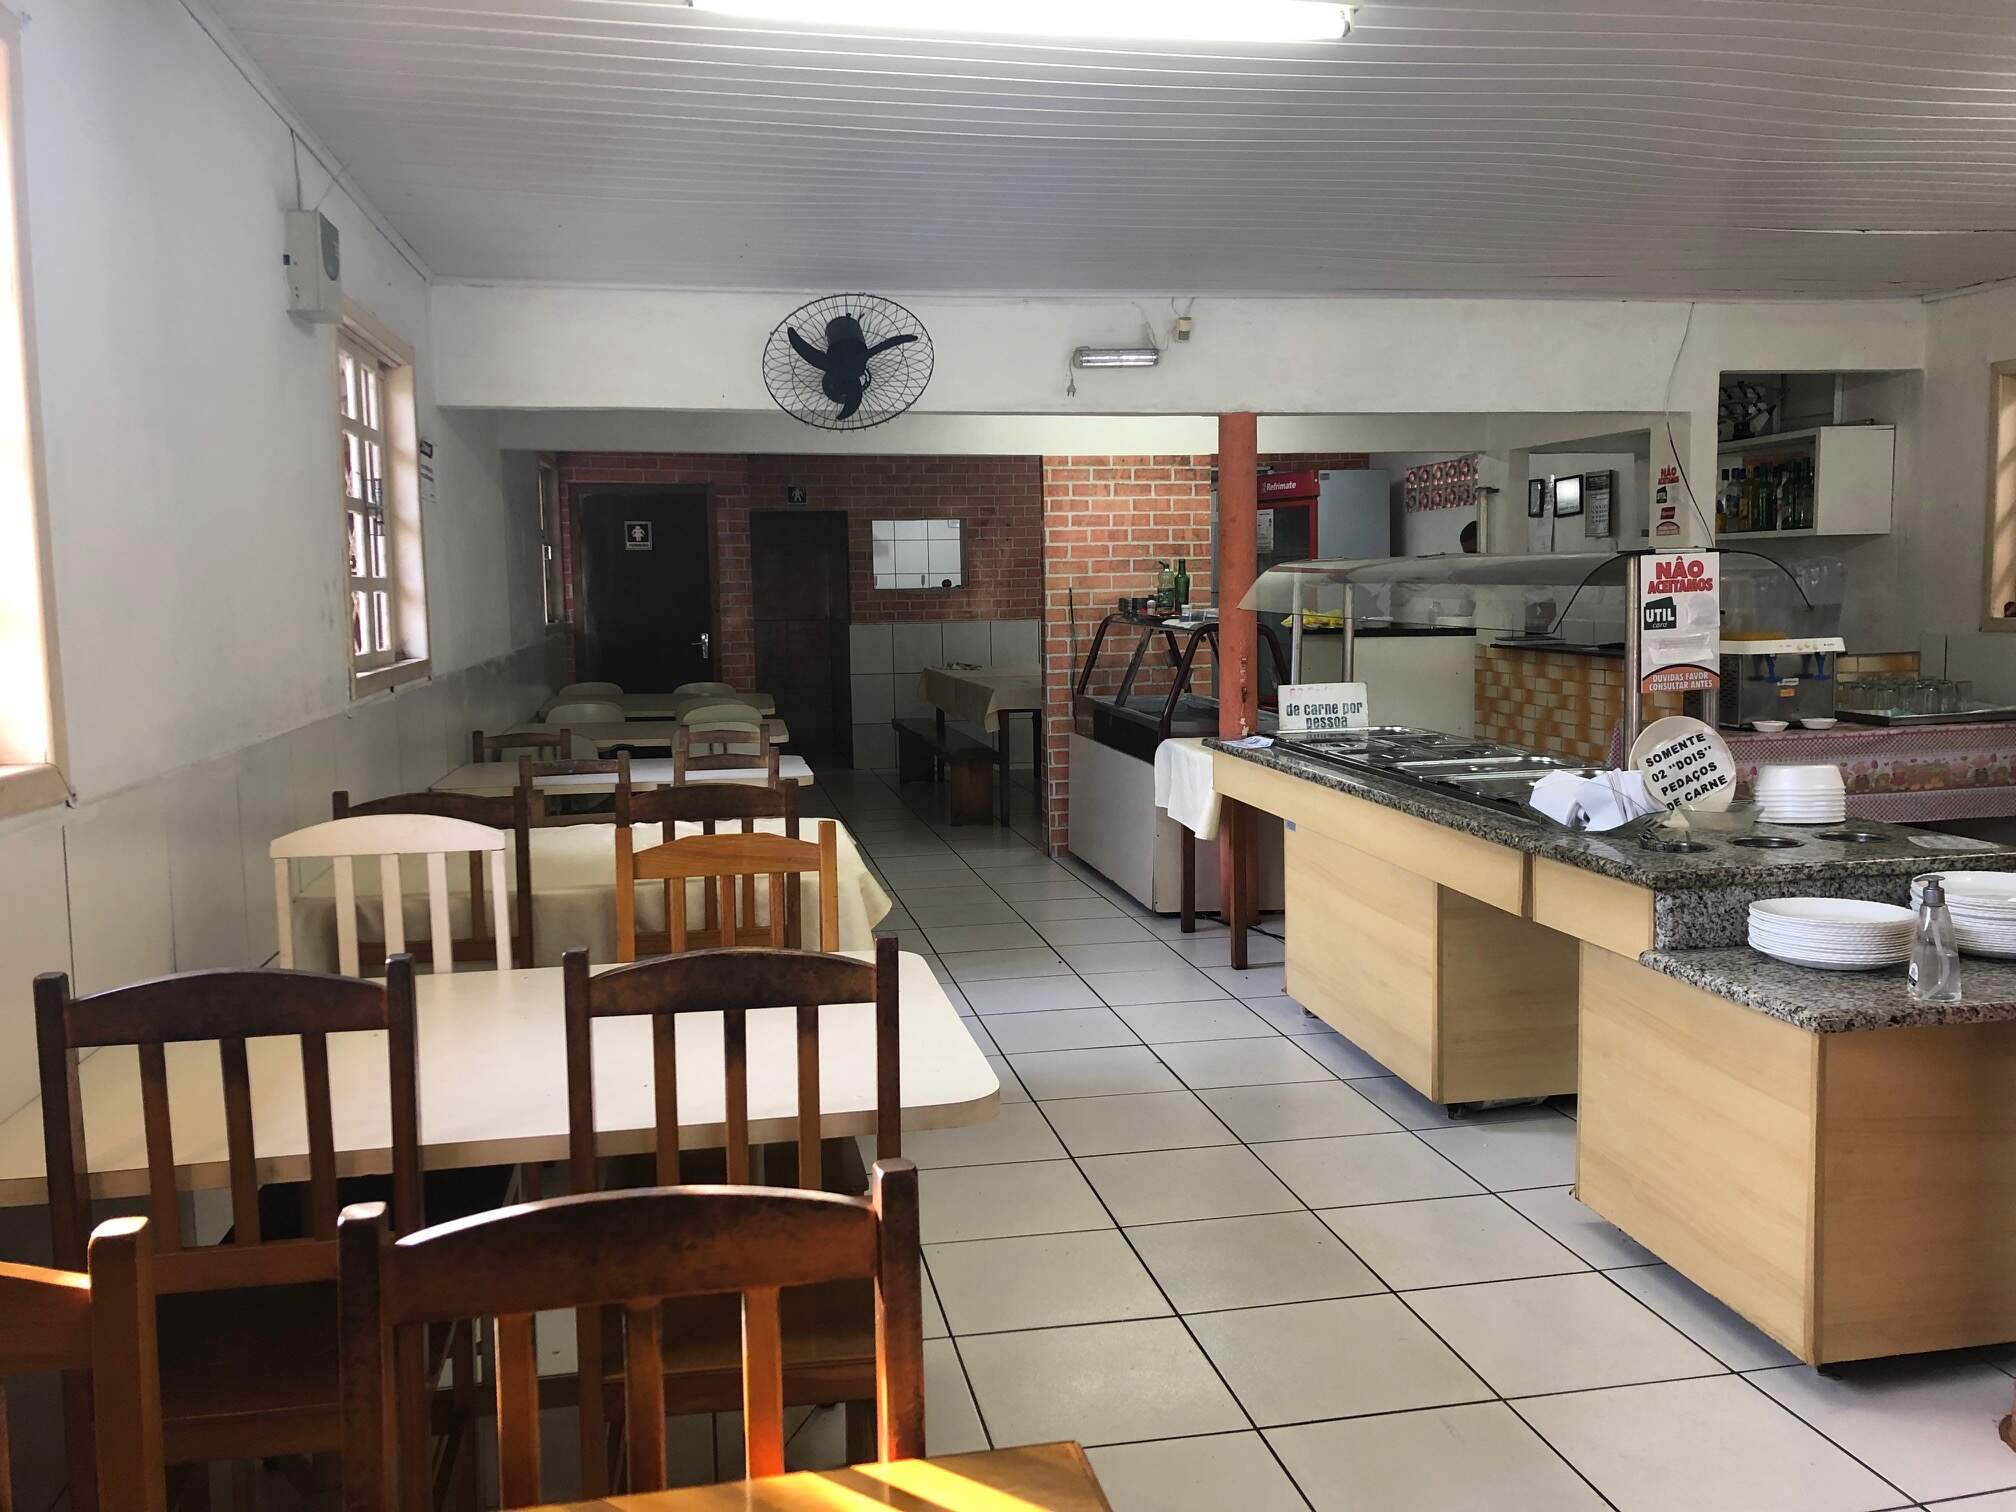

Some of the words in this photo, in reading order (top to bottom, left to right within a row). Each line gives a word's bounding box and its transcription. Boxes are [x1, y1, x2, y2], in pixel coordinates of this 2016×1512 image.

[1648, 578, 1713, 594] ACEITAMOS
[1645, 608, 1675, 622] UTIL
[1685, 671, 1709, 680] FAVOR
[1649, 681, 1689, 691] CONSULTAR
[1690, 679, 1713, 688] ANTES
[1286, 703, 1300, 716] de
[1304, 703, 1339, 716] carne
[1342, 701, 1363, 715] por
[1305, 715, 1348, 729] pessoa
[1645, 733, 1706, 767] SOMENTE
[1651, 769, 1668, 783] 02
[1668, 745, 1712, 771] "DOIS"
[1661, 762, 1717, 796] PEDAÇOS
[1666, 797, 1683, 811] DE
[1684, 774, 1728, 803] CARNE
